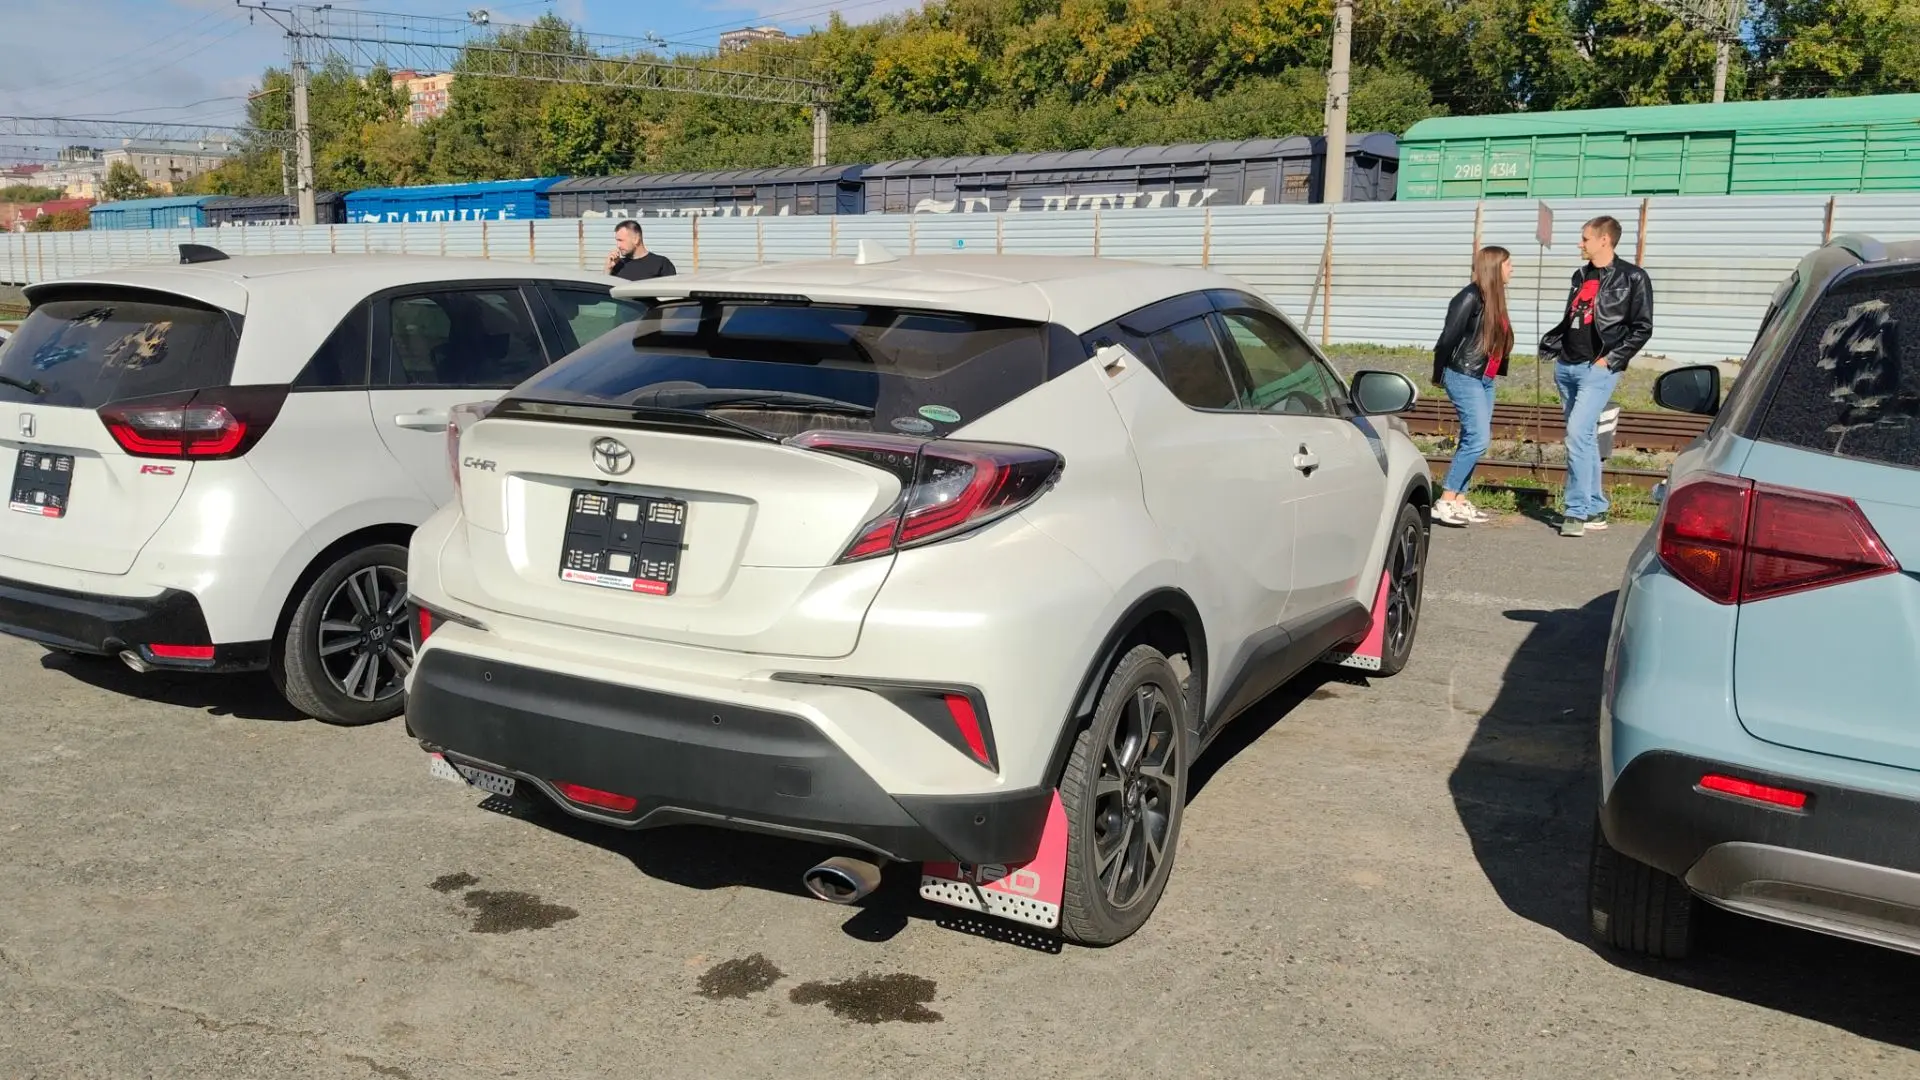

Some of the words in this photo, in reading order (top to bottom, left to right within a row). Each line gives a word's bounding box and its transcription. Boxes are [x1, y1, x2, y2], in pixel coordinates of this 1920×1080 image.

[1454, 164, 1482, 178] 2918
[1489, 162, 1517, 177] 4314
[140, 464, 176, 475] RS
[957, 862, 1041, 896] RD
